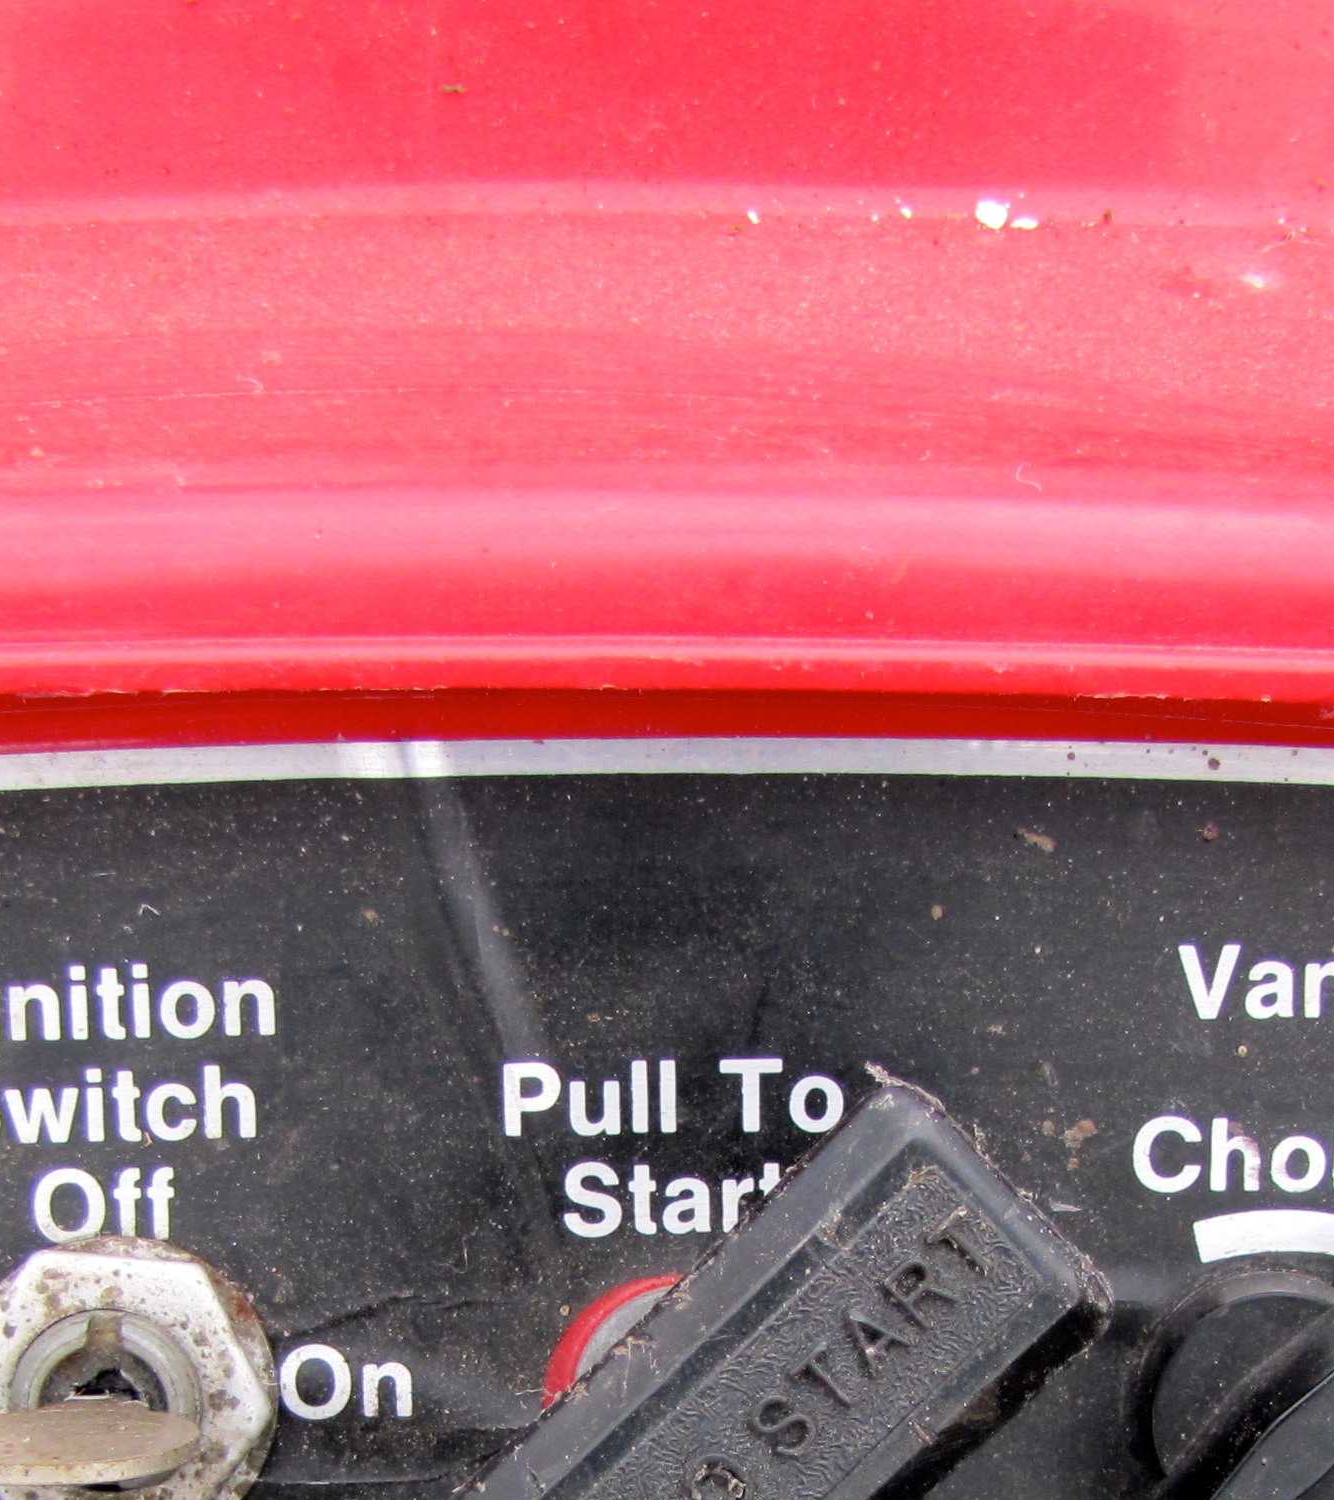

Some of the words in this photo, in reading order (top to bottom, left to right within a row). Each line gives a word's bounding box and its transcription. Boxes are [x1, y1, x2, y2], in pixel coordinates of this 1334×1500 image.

[502, 1059, 677, 1137] Pull
[719, 1057, 844, 1133] To
[33, 1166, 175, 1243] Off
[747, 1205, 991, 1456] START
[279, 1343, 413, 1420] On
